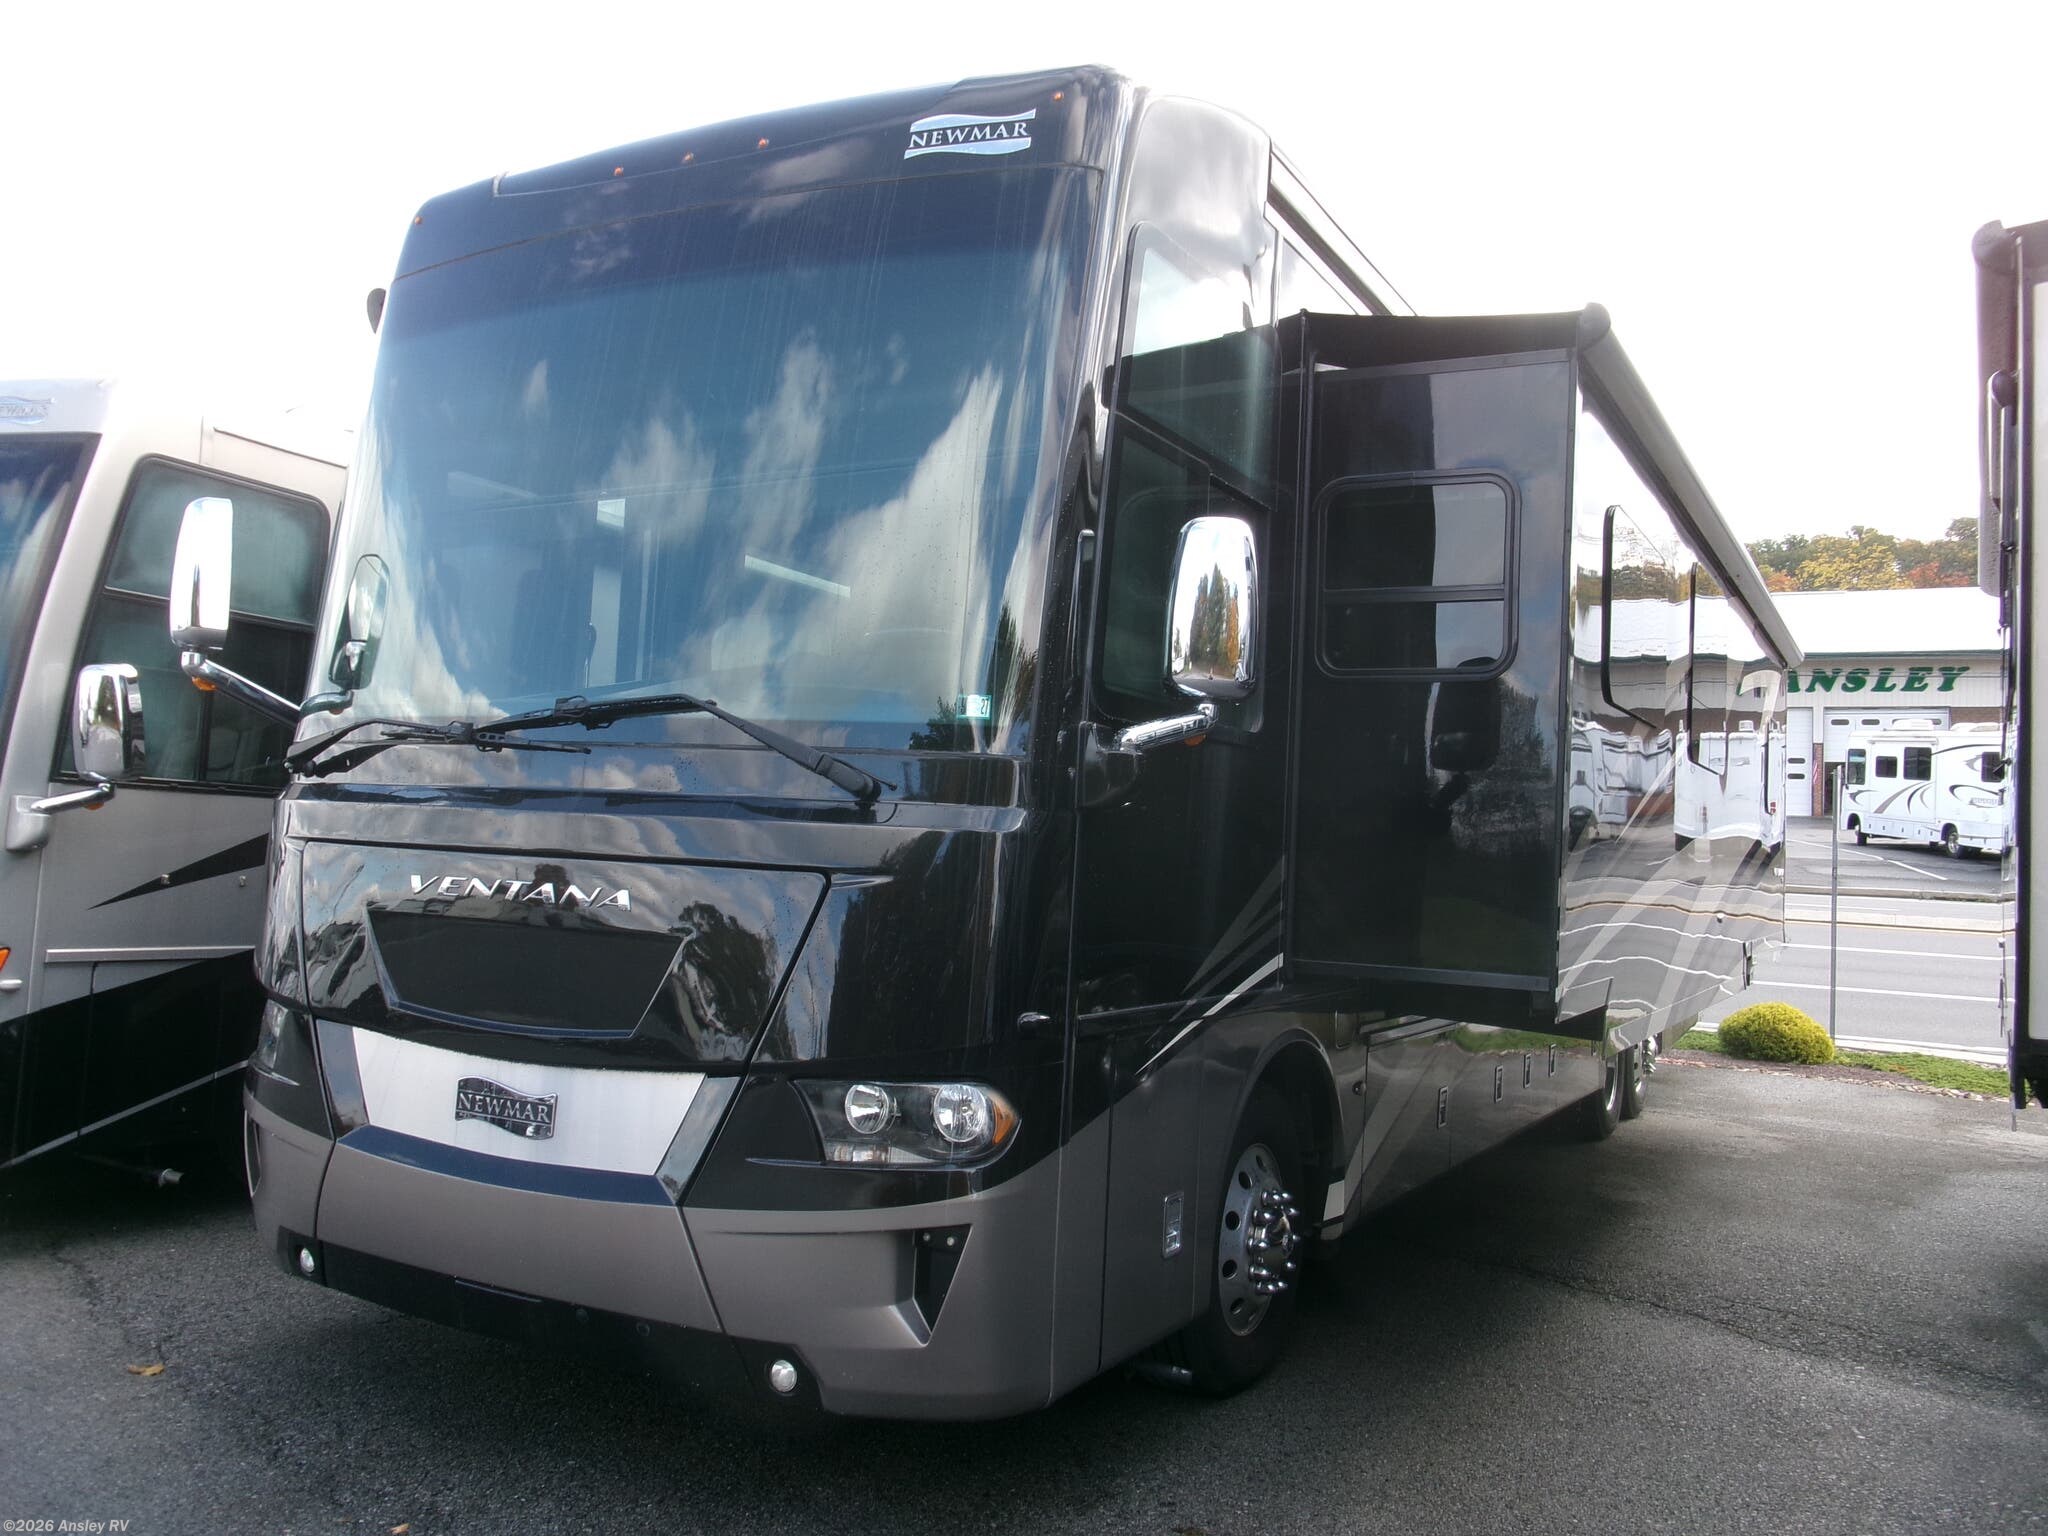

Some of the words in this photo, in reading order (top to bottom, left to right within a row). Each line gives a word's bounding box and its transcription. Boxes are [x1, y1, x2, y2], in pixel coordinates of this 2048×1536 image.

[908, 122, 1030, 149] NEWMAR
[410, 874, 632, 912] VENTANA
[457, 1093, 551, 1123] NEWMAR
